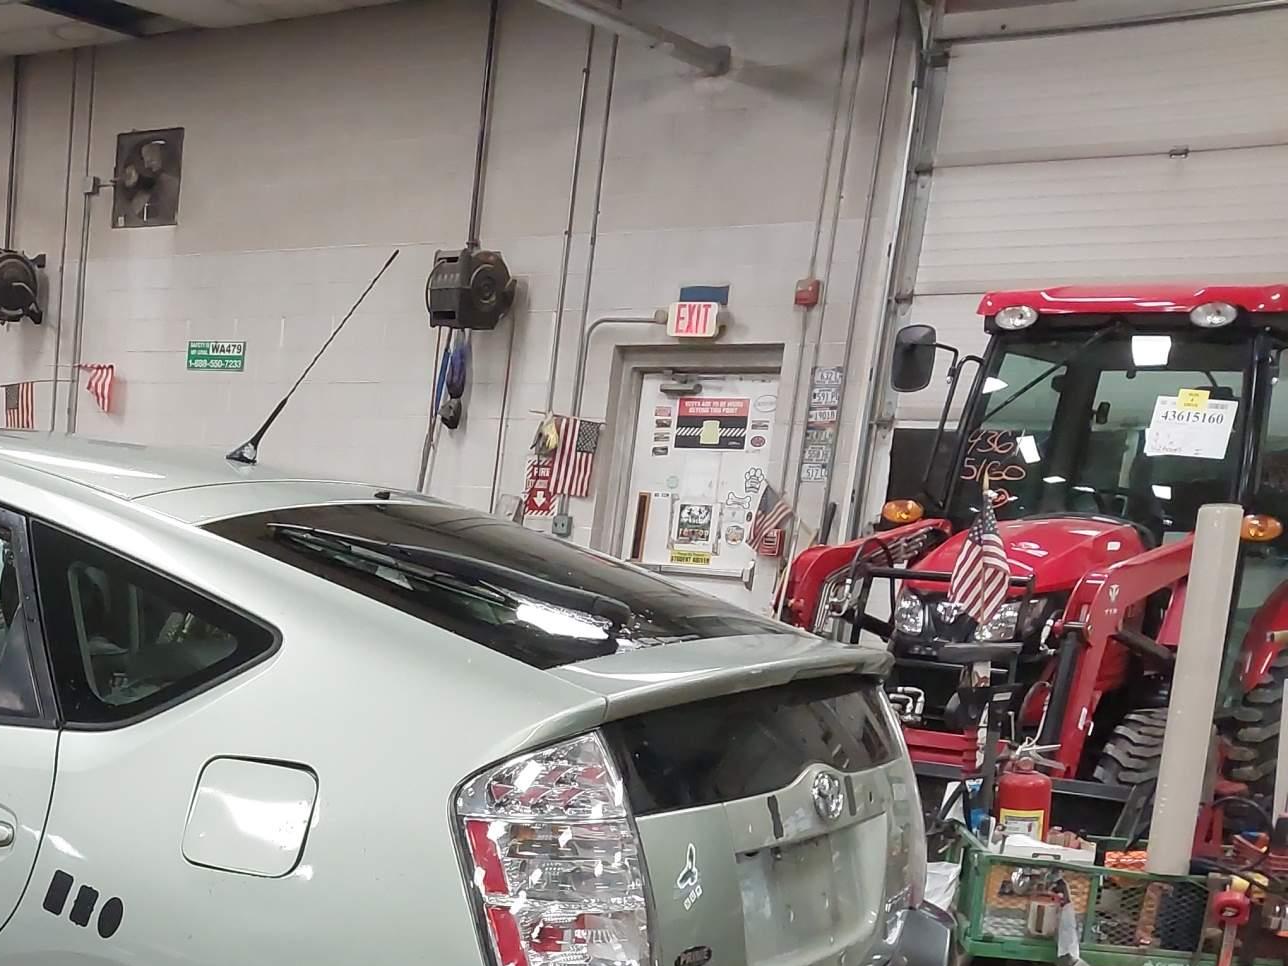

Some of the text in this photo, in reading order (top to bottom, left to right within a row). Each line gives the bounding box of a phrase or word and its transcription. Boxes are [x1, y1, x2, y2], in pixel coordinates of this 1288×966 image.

[675, 303, 712, 334] EXIT
[211, 344, 243, 354] WA479
[1161, 410, 1224, 425] 43615160
[960, 457, 1026, 482] 5160
